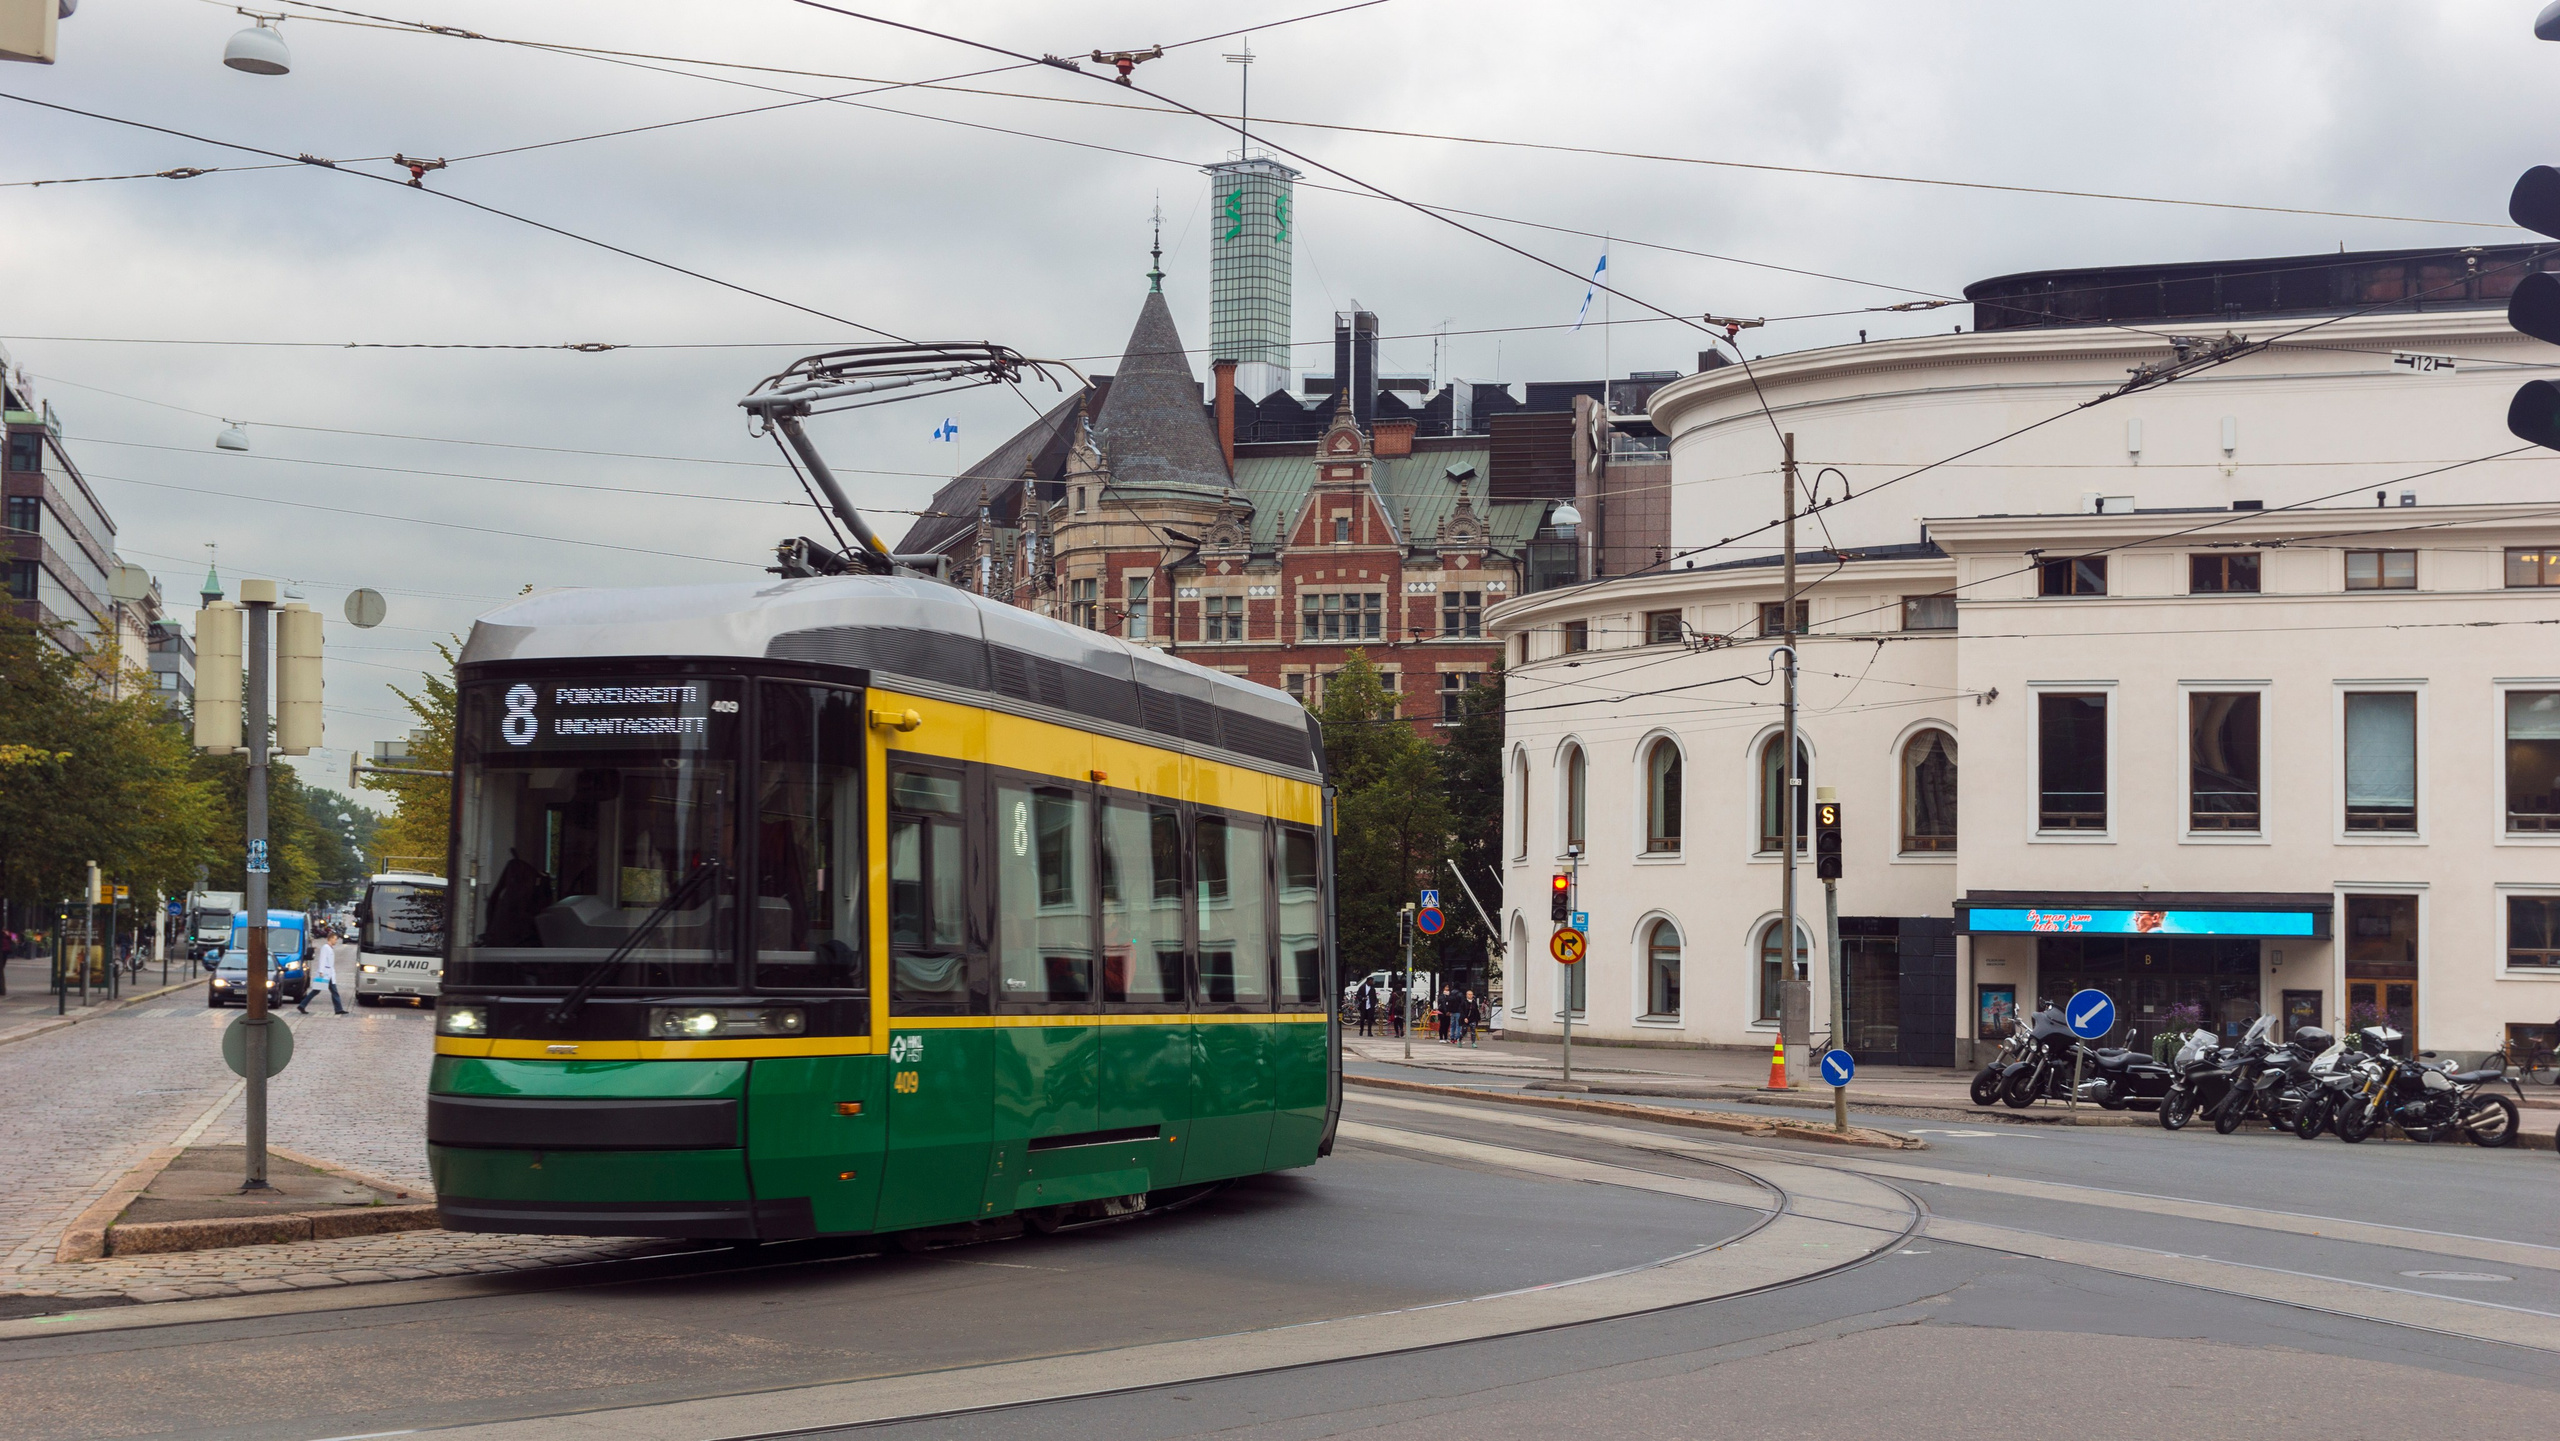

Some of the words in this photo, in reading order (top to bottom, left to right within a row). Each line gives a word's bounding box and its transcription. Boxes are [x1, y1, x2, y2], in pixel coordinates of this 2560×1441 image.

[2417, 356, 2433, 371] 12
[501, 684, 539, 745] 8
[711, 700, 740, 713] 409
[554, 717, 708, 734] UNDANTAGSRUTT
[1822, 806, 1835, 825] S
[1013, 801, 1028, 857] 8
[387, 960, 429, 970] VAINIO
[2145, 954, 2152, 965] B
[894, 1071, 919, 1094] 409
